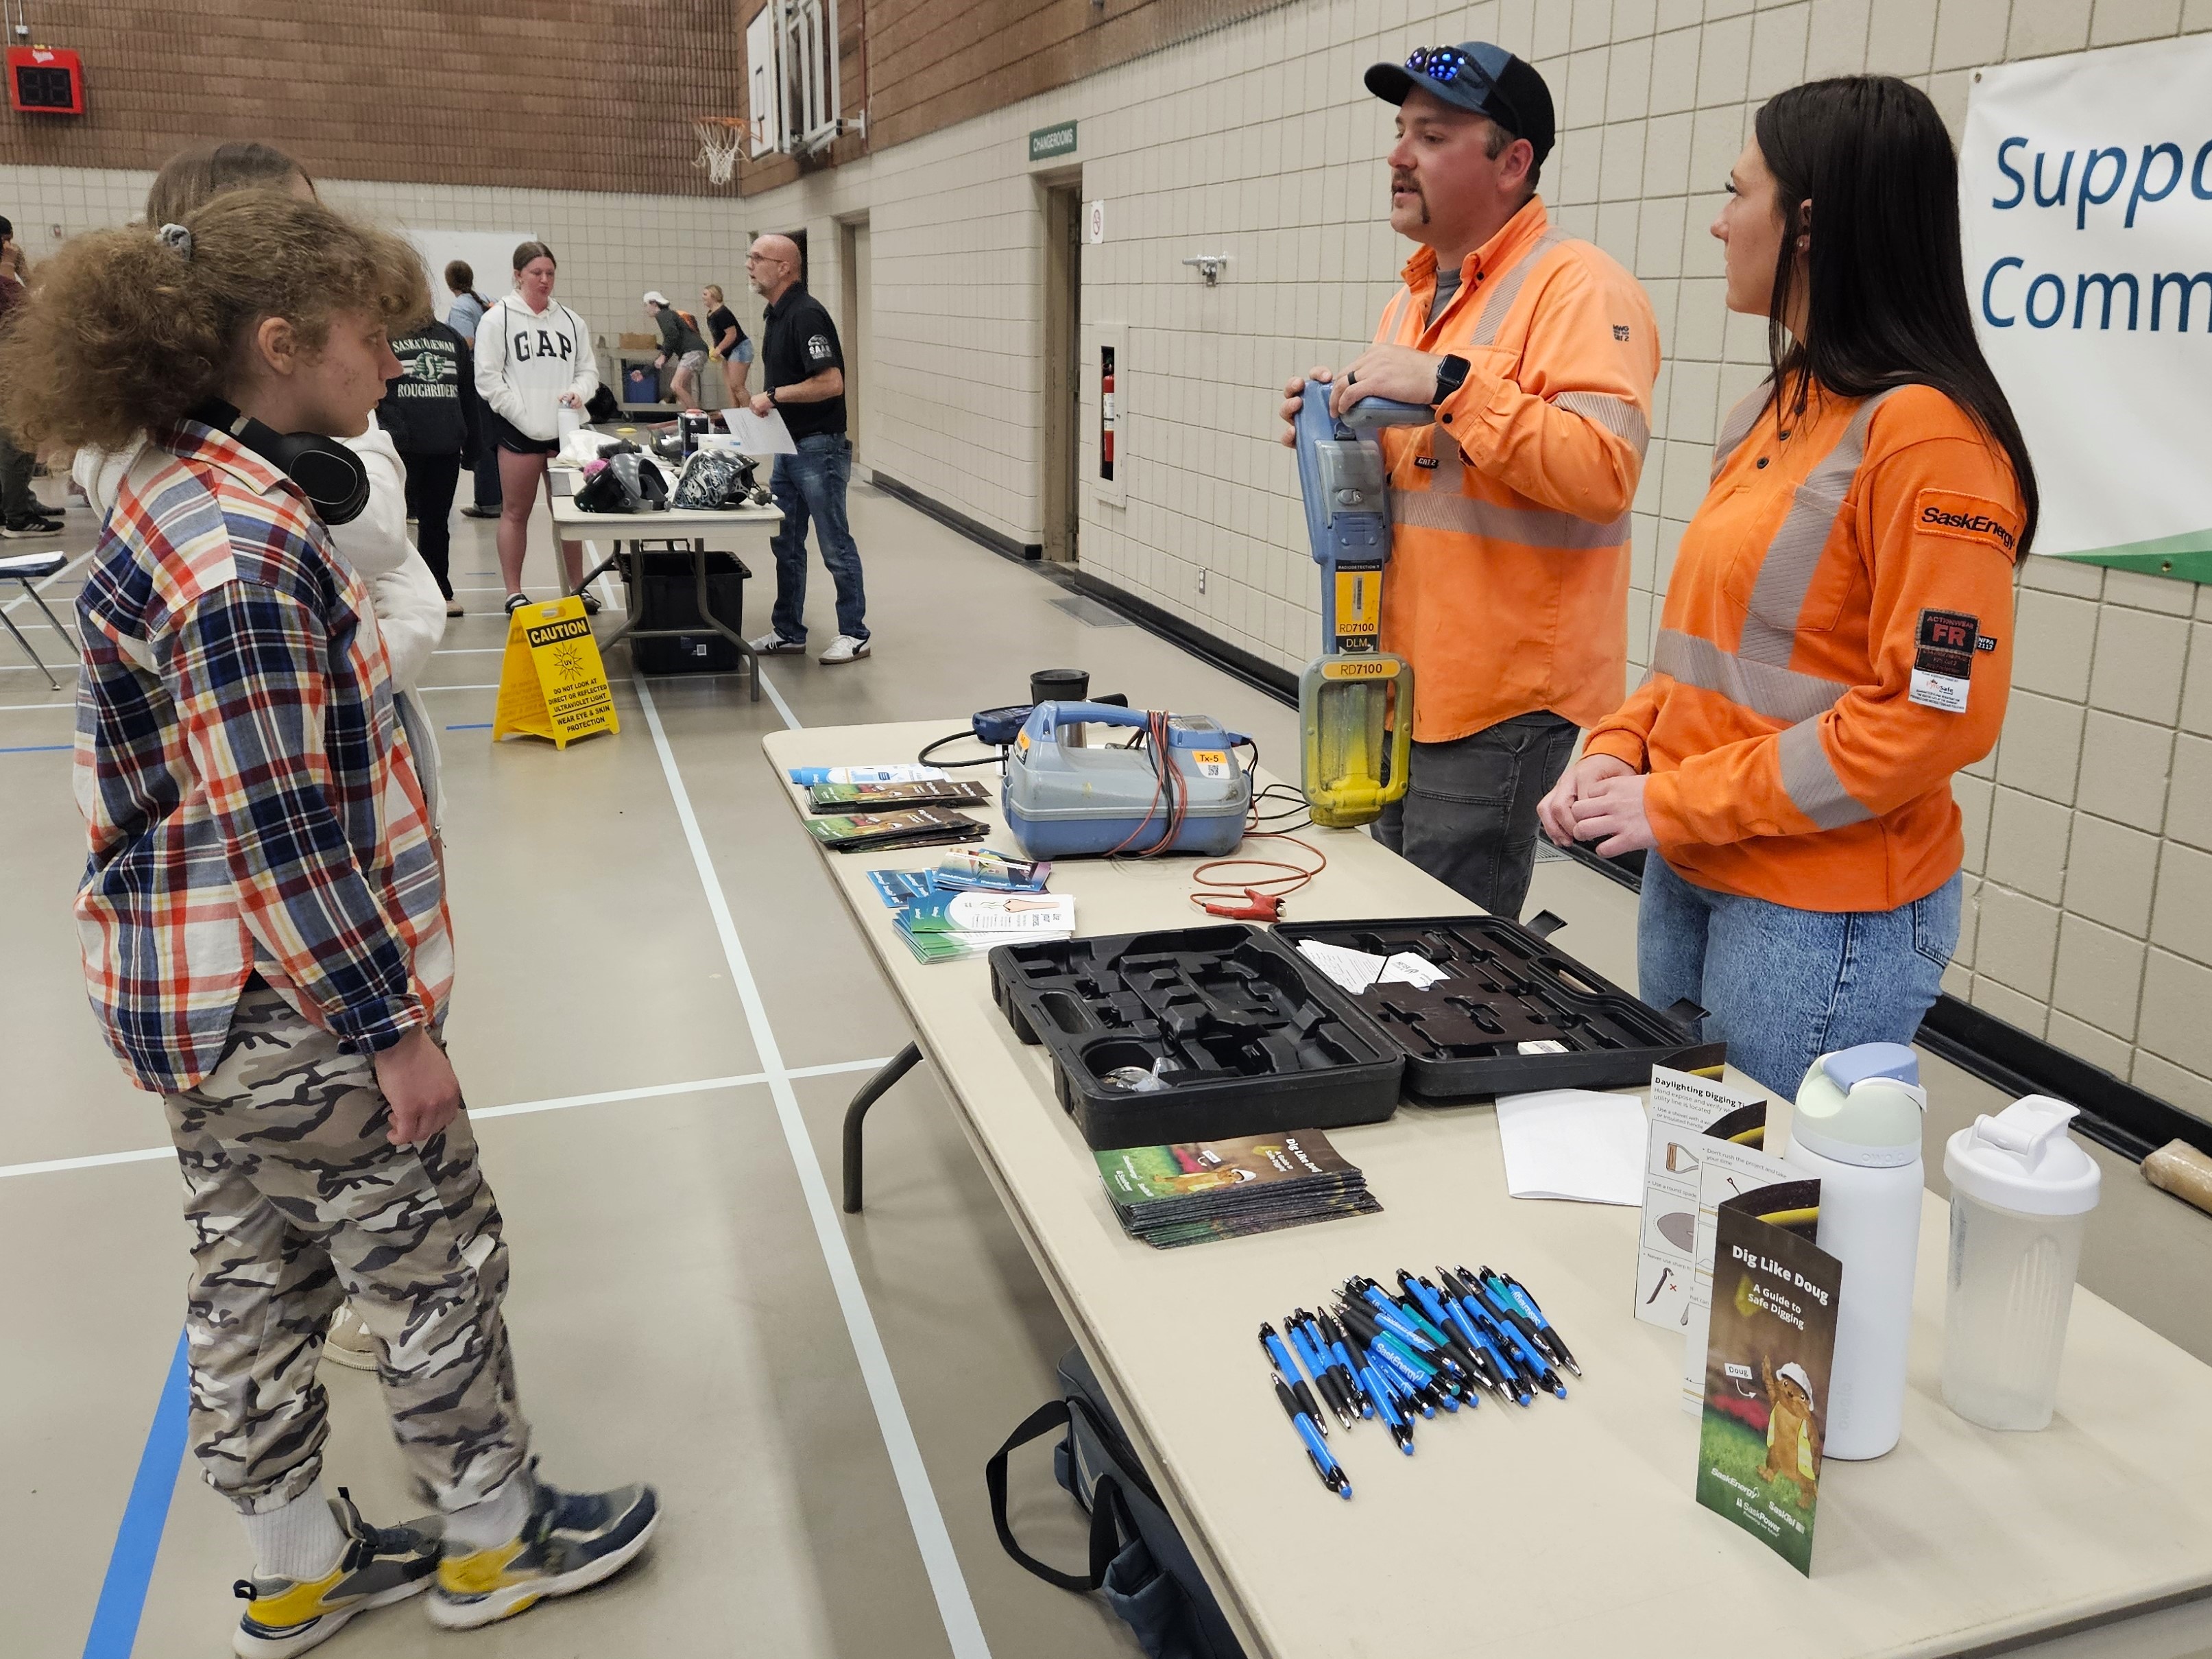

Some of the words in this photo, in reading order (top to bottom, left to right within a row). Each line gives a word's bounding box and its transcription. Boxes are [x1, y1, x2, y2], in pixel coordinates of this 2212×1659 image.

[514, 329, 573, 362] GAP
[397, 383, 459, 398] ROUGHRIDERS
[1418, 457, 1431, 466] CAT
[1921, 507, 2015, 550] SaskEnergy
[531, 619, 588, 644] CAUTION
[1339, 623, 1374, 632] RD7100
[1927, 616, 1974, 630] ACTIONWEAR
[1346, 638, 1367, 648] DLM
[1932, 623, 1967, 647] FR
[1978, 636, 1995, 646] NFPA
[1977, 642, 1993, 650] 2112
[1341, 663, 1382, 675] RD7100
[549, 695, 567, 706] DIRECT
[577, 684, 608, 697] REFLECTED
[575, 680, 590, 689] LOOK
[553, 698, 589, 713] ULTRAVIOLET
[590, 693, 607, 703] LIGHT
[557, 714, 575, 726] WEAR
[576, 711, 588, 720] EYE
[595, 704, 610, 715] SKIN
[566, 715, 605, 733] PROTECTION
[1654, 1087, 1670, 1097] Hand
[1672, 1092, 1693, 1104] expose
[1694, 1097, 1705, 1106] and
[1706, 1100, 1722, 1112] verify
[1655, 1077, 1703, 1097] Daylighting
[1705, 1090, 1736, 1108] Digging
[1653, 1095, 1670, 1105] utility
[1671, 1098, 1682, 1107] line
[1689, 1103, 1711, 1114] located
[1686, 1120, 1704, 1130] handle
[1286, 1138, 1299, 1151] Dig
[1295, 1149, 1310, 1165] Like
[1706, 1156, 1720, 1165] your
[1720, 1158, 1733, 1166] time
[1707, 1148, 1722, 1157] Don't
[1722, 1152, 1735, 1160] rush
[1745, 1159, 1764, 1171] project
[1765, 1166, 1775, 1174] and
[1775, 1169, 1787, 1179] take
[1666, 1185, 1682, 1194] round
[1682, 1190, 1697, 1198] spade
[1647, 1253, 1662, 1261] Never
[1672, 1262, 1686, 1270] sharp
[1732, 1245, 1757, 1269] Dig
[1760, 1256, 1792, 1282] Like
[1794, 1272, 1829, 1306] Doug
[1753, 1284, 1761, 1294] A
[1762, 1287, 1790, 1309] Guide
[1791, 1302, 1801, 1314] to
[1748, 1293, 1769, 1309] Safe
[1770, 1303, 1805, 1330] Digging
[1375, 1342, 1421, 1383] SaskEnergy
[1729, 1366, 1748, 1378] Doug
[1711, 1468, 1757, 1499] SaskEnergy
[1743, 1502, 1781, 1533] SaskPower
[1768, 1501, 1796, 1527] SaskTel
